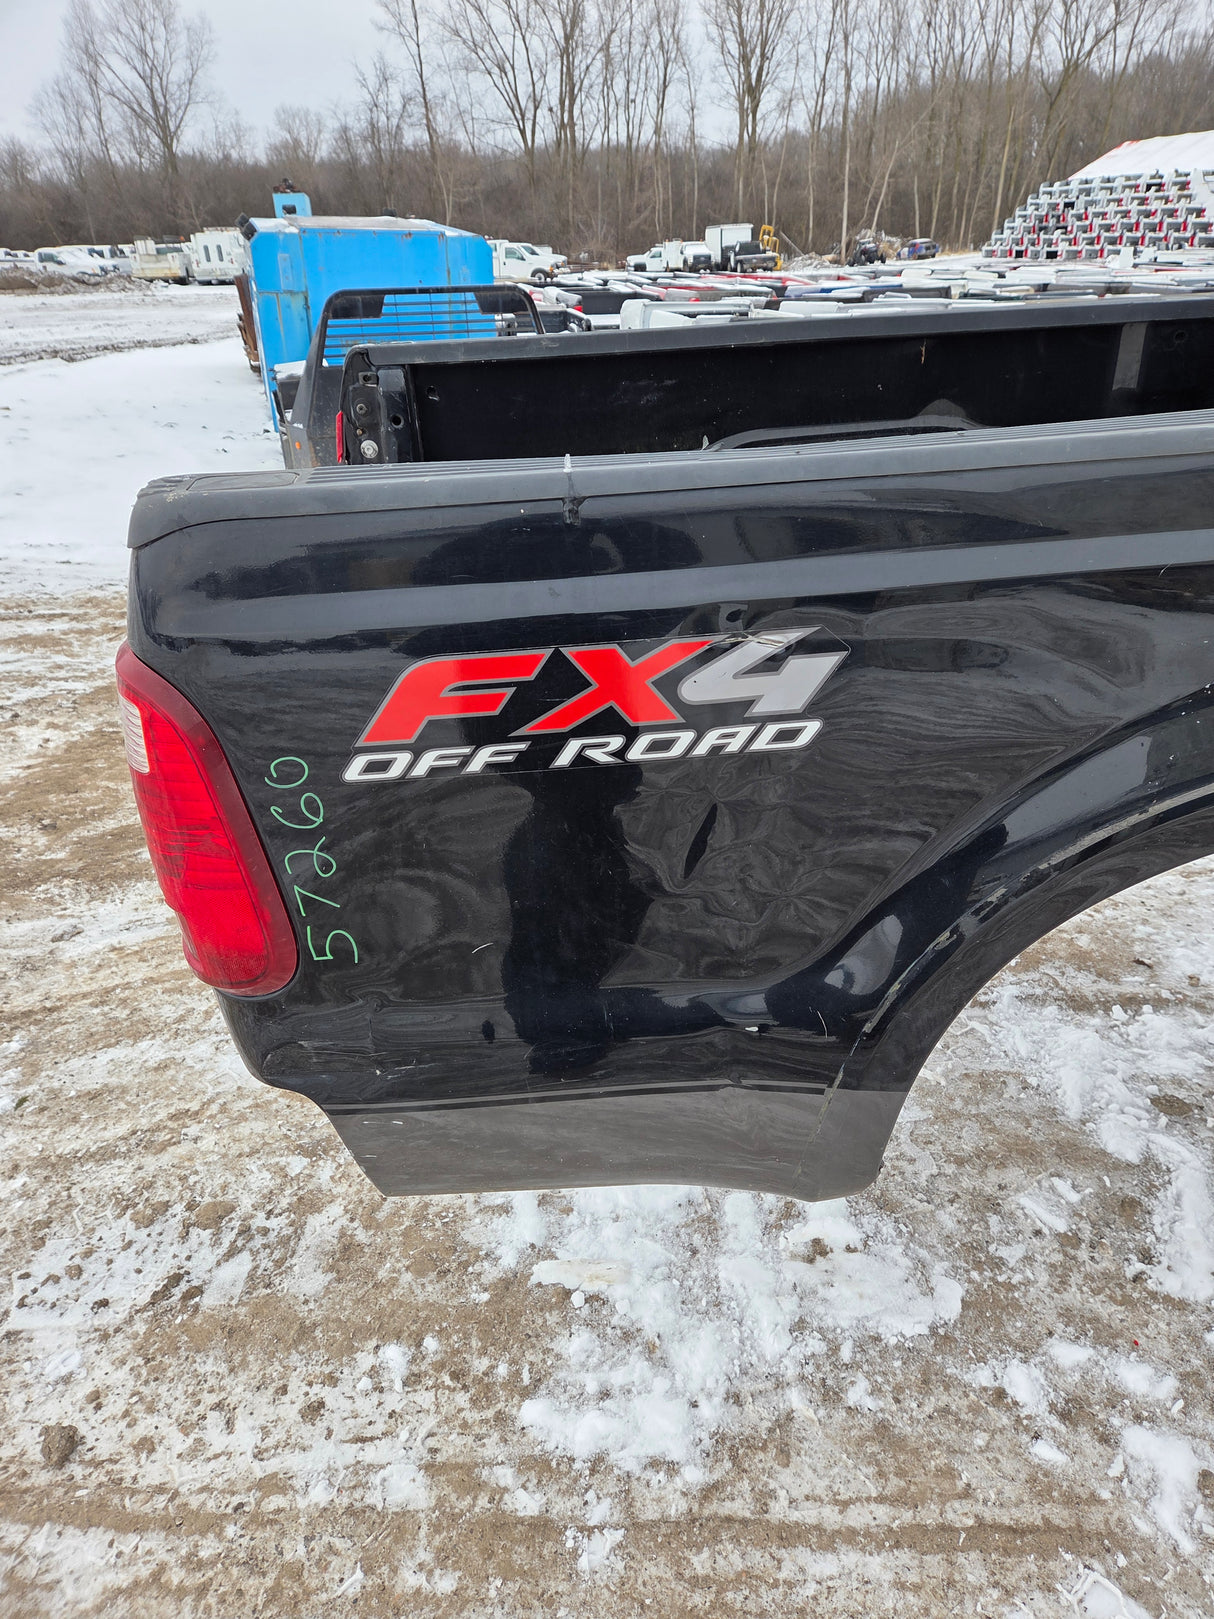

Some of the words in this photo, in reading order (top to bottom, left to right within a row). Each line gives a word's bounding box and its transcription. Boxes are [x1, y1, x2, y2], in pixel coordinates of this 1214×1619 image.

[355, 626, 849, 747] FX4
[343, 742, 529, 783] OFF
[550, 720, 823, 768] ROAD
[264, 756, 359, 964] 57260
